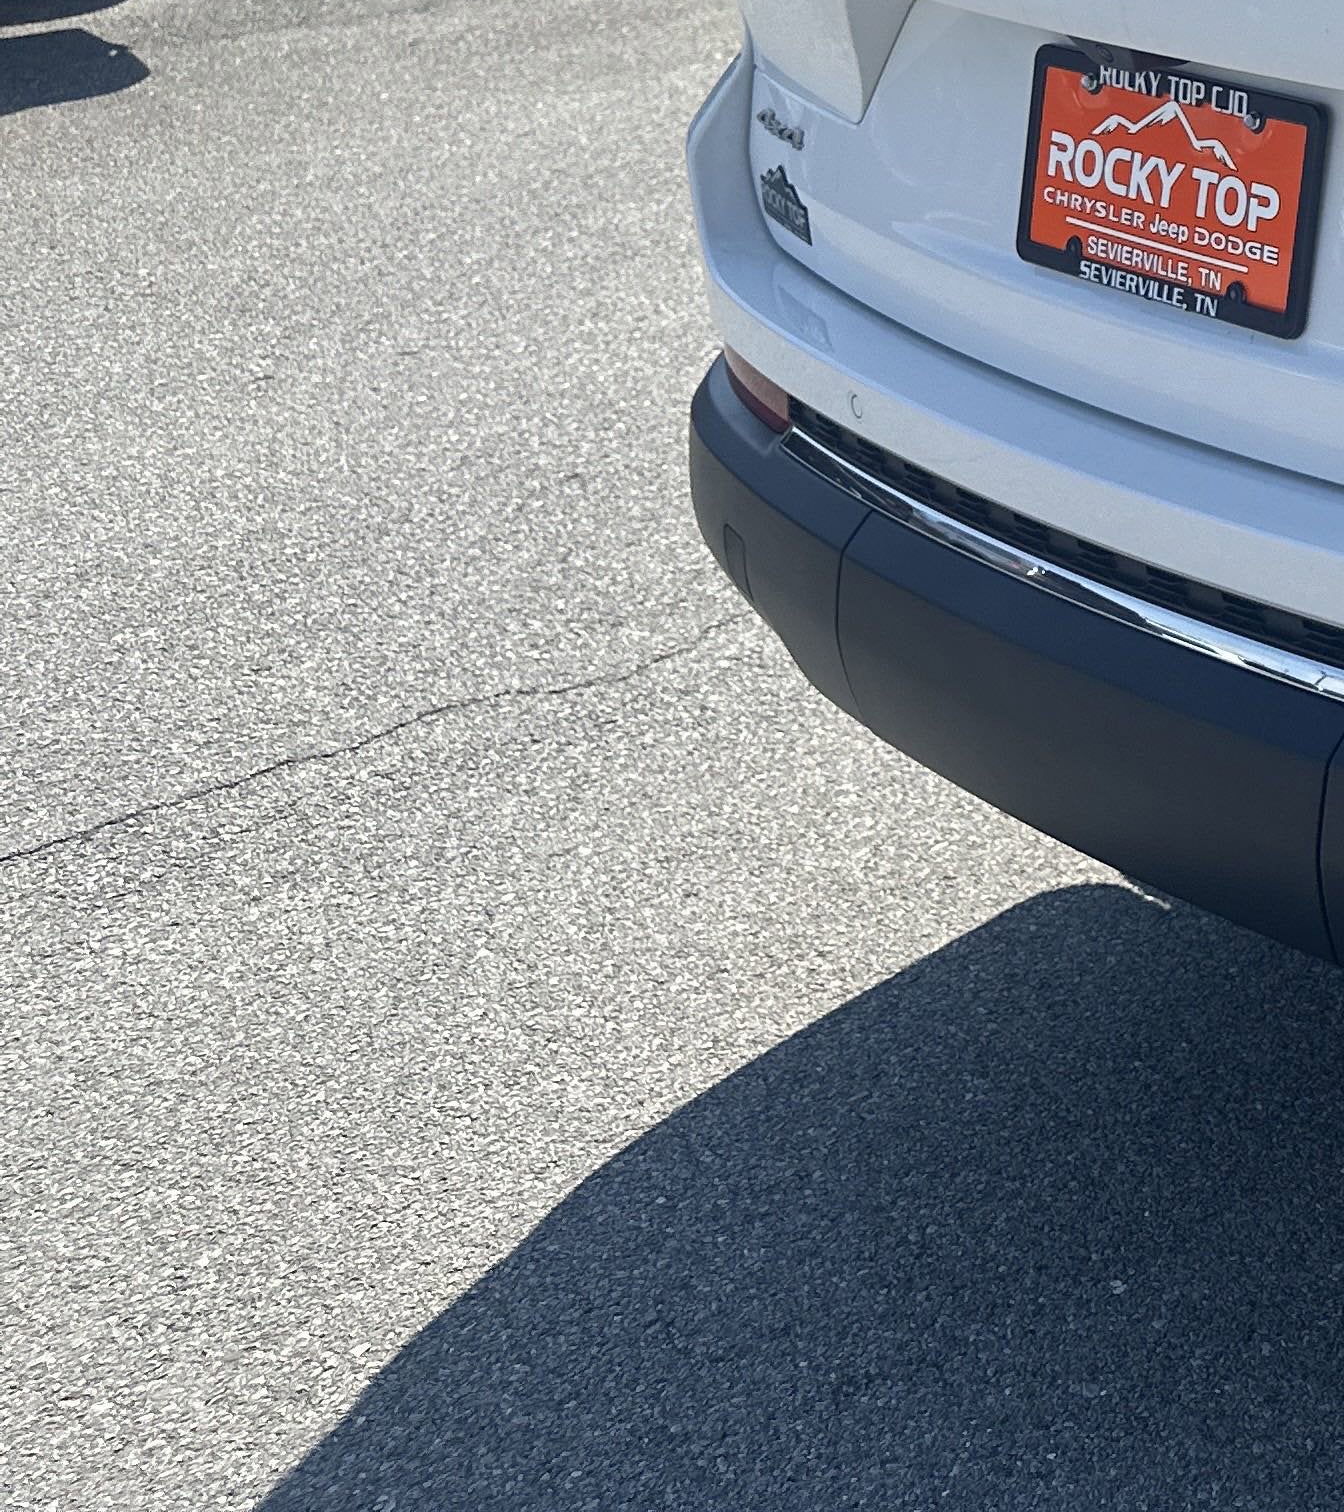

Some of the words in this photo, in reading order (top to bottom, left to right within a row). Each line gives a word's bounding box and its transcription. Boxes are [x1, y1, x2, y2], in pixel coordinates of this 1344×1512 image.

[1167, 75, 1206, 105] TOP
[1212, 86, 1249, 118] CJD
[1047, 130, 1186, 208] ROCKY
[1191, 167, 1280, 232] TOP
[1043, 187, 1145, 229] CHRYSLER
[1149, 213, 1188, 244] Jeep
[1193, 227, 1279, 265] DODGE
[1079, 259, 1188, 311] SEVIERVILLE,
[1194, 292, 1219, 317] TN
[1087, 236, 1193, 287] SEVIERVILLE,
[1198, 267, 1222, 291] TN
